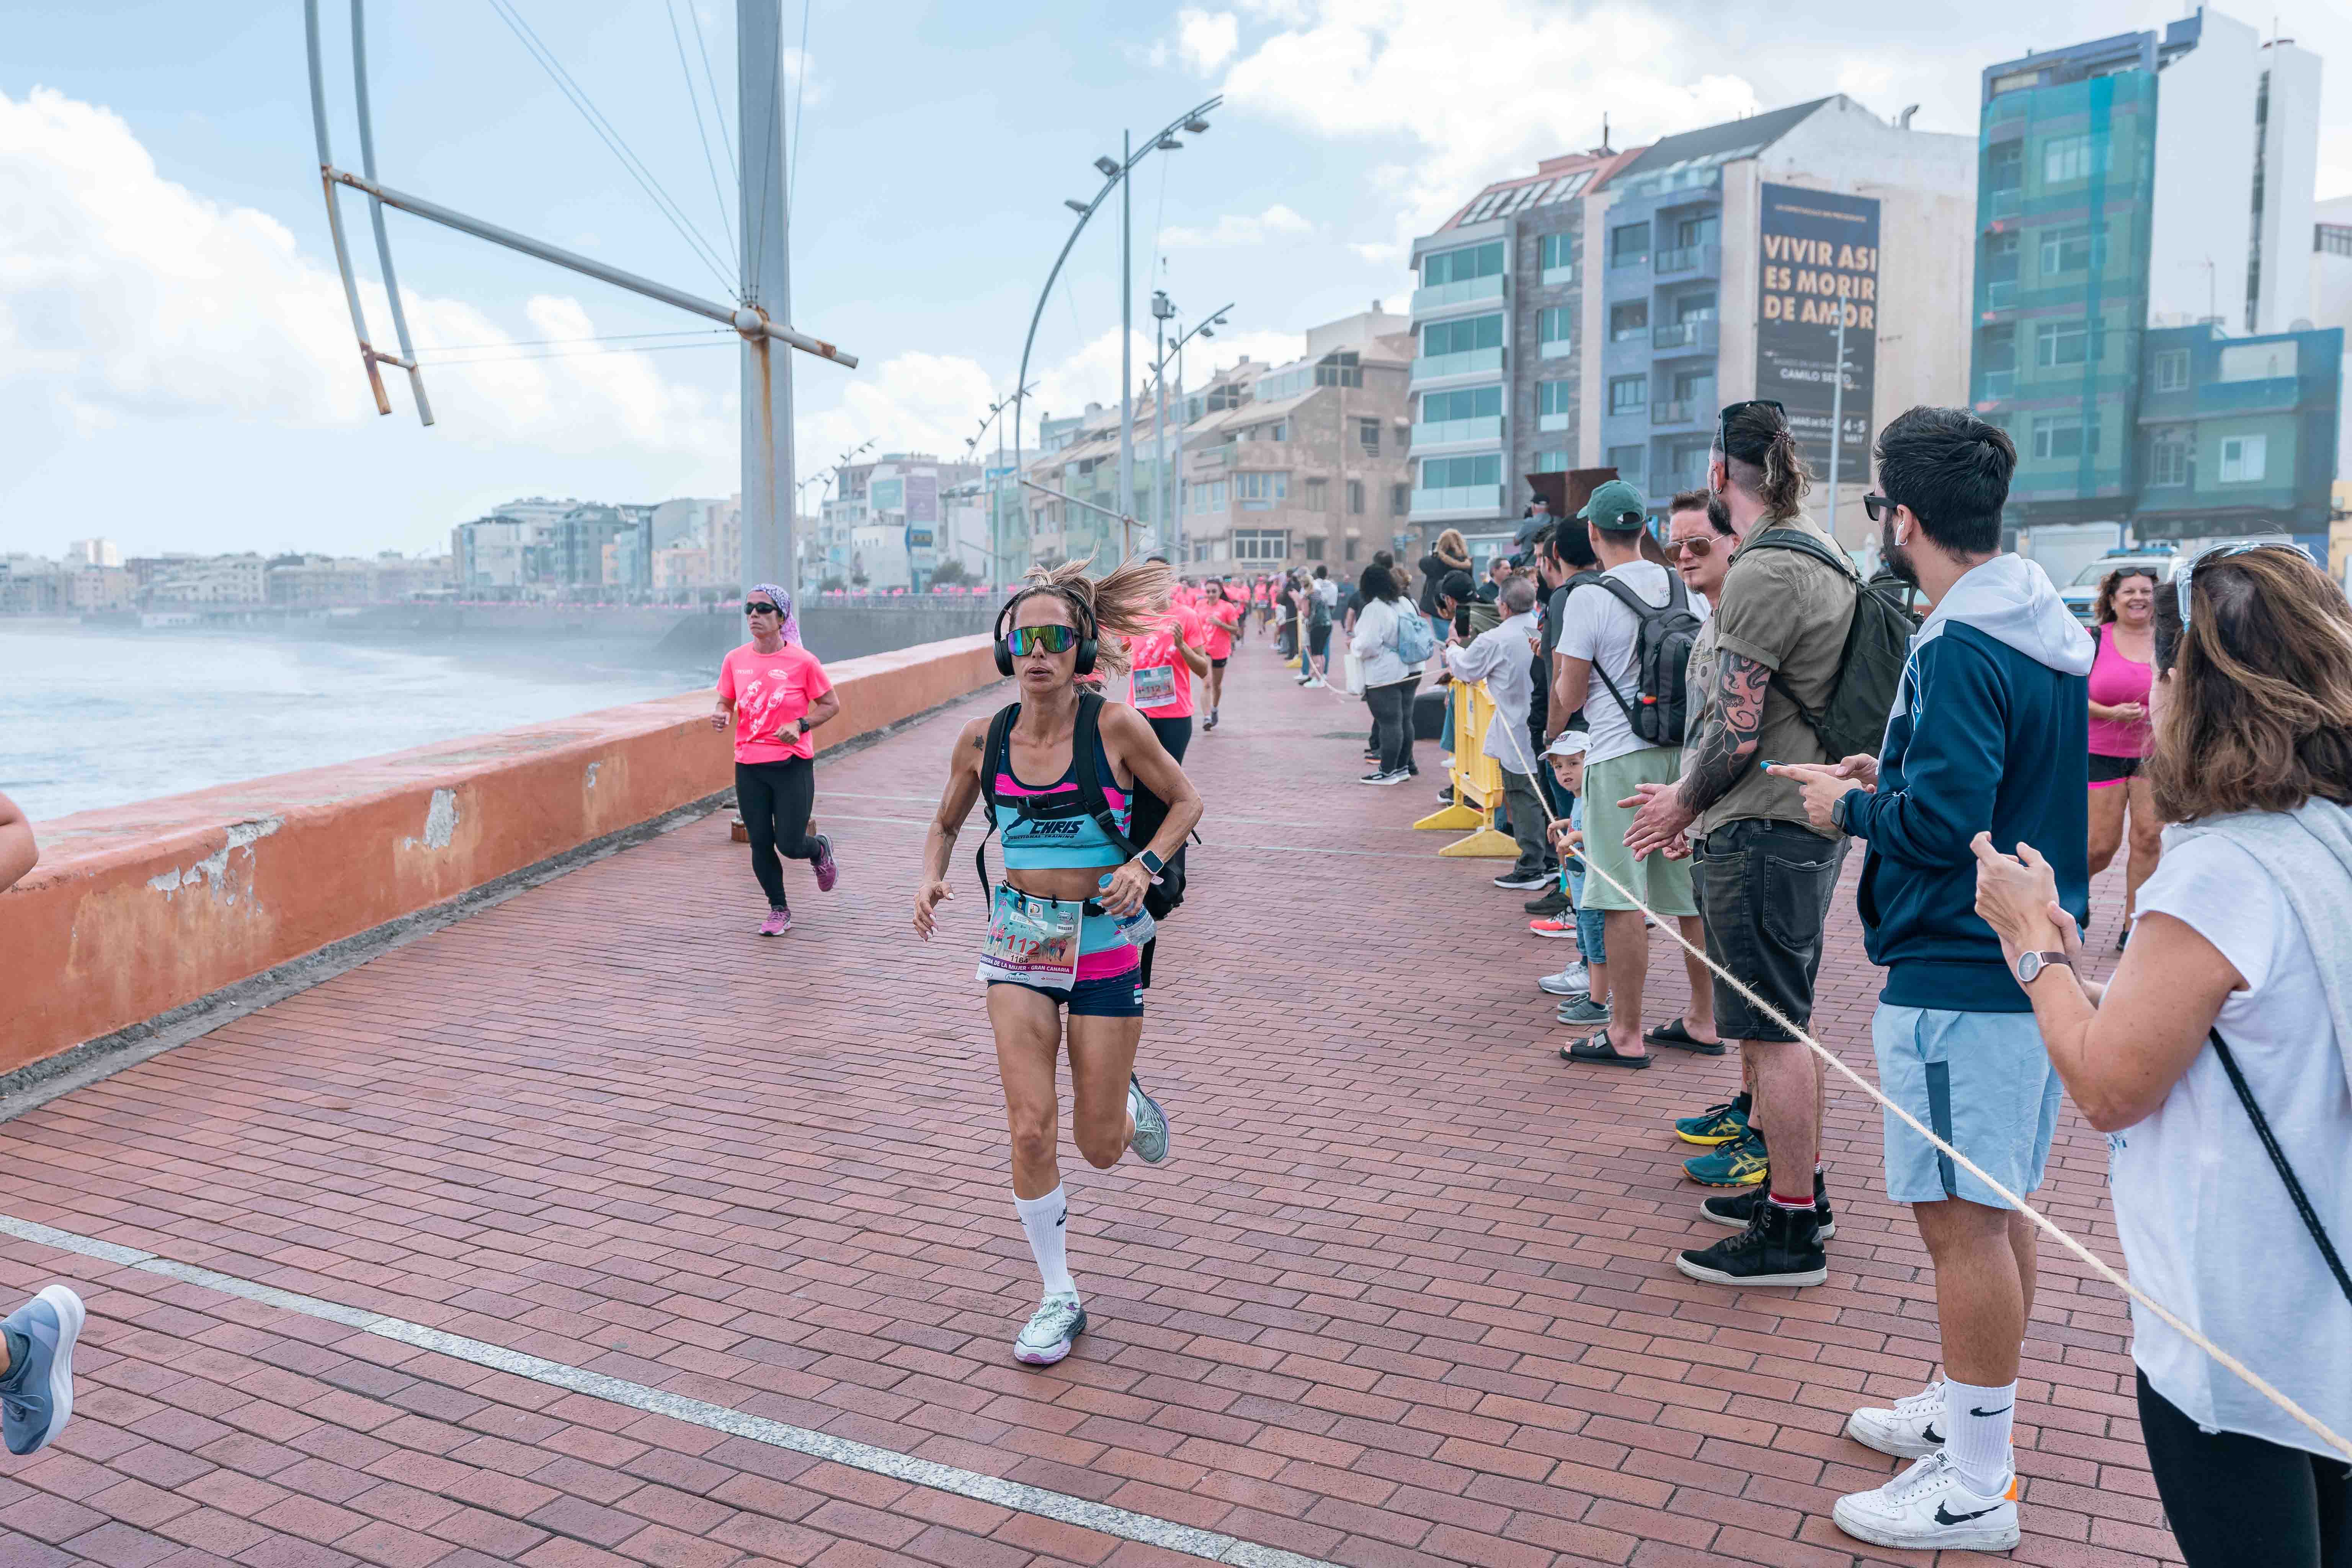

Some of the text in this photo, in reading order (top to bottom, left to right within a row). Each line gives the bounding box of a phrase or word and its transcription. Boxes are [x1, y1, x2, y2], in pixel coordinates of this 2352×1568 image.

[1763, 234, 1877, 273] VIVIR ASI
[1764, 265, 1875, 301] ES MORIR
[1764, 294, 1874, 330] DE AMOR
[1780, 368, 1820, 382] CAMILO
[1029, 820, 1086, 835] CHRIS
[1006, 934, 1040, 956] 112
[1011, 954, 1028, 964] 1164
